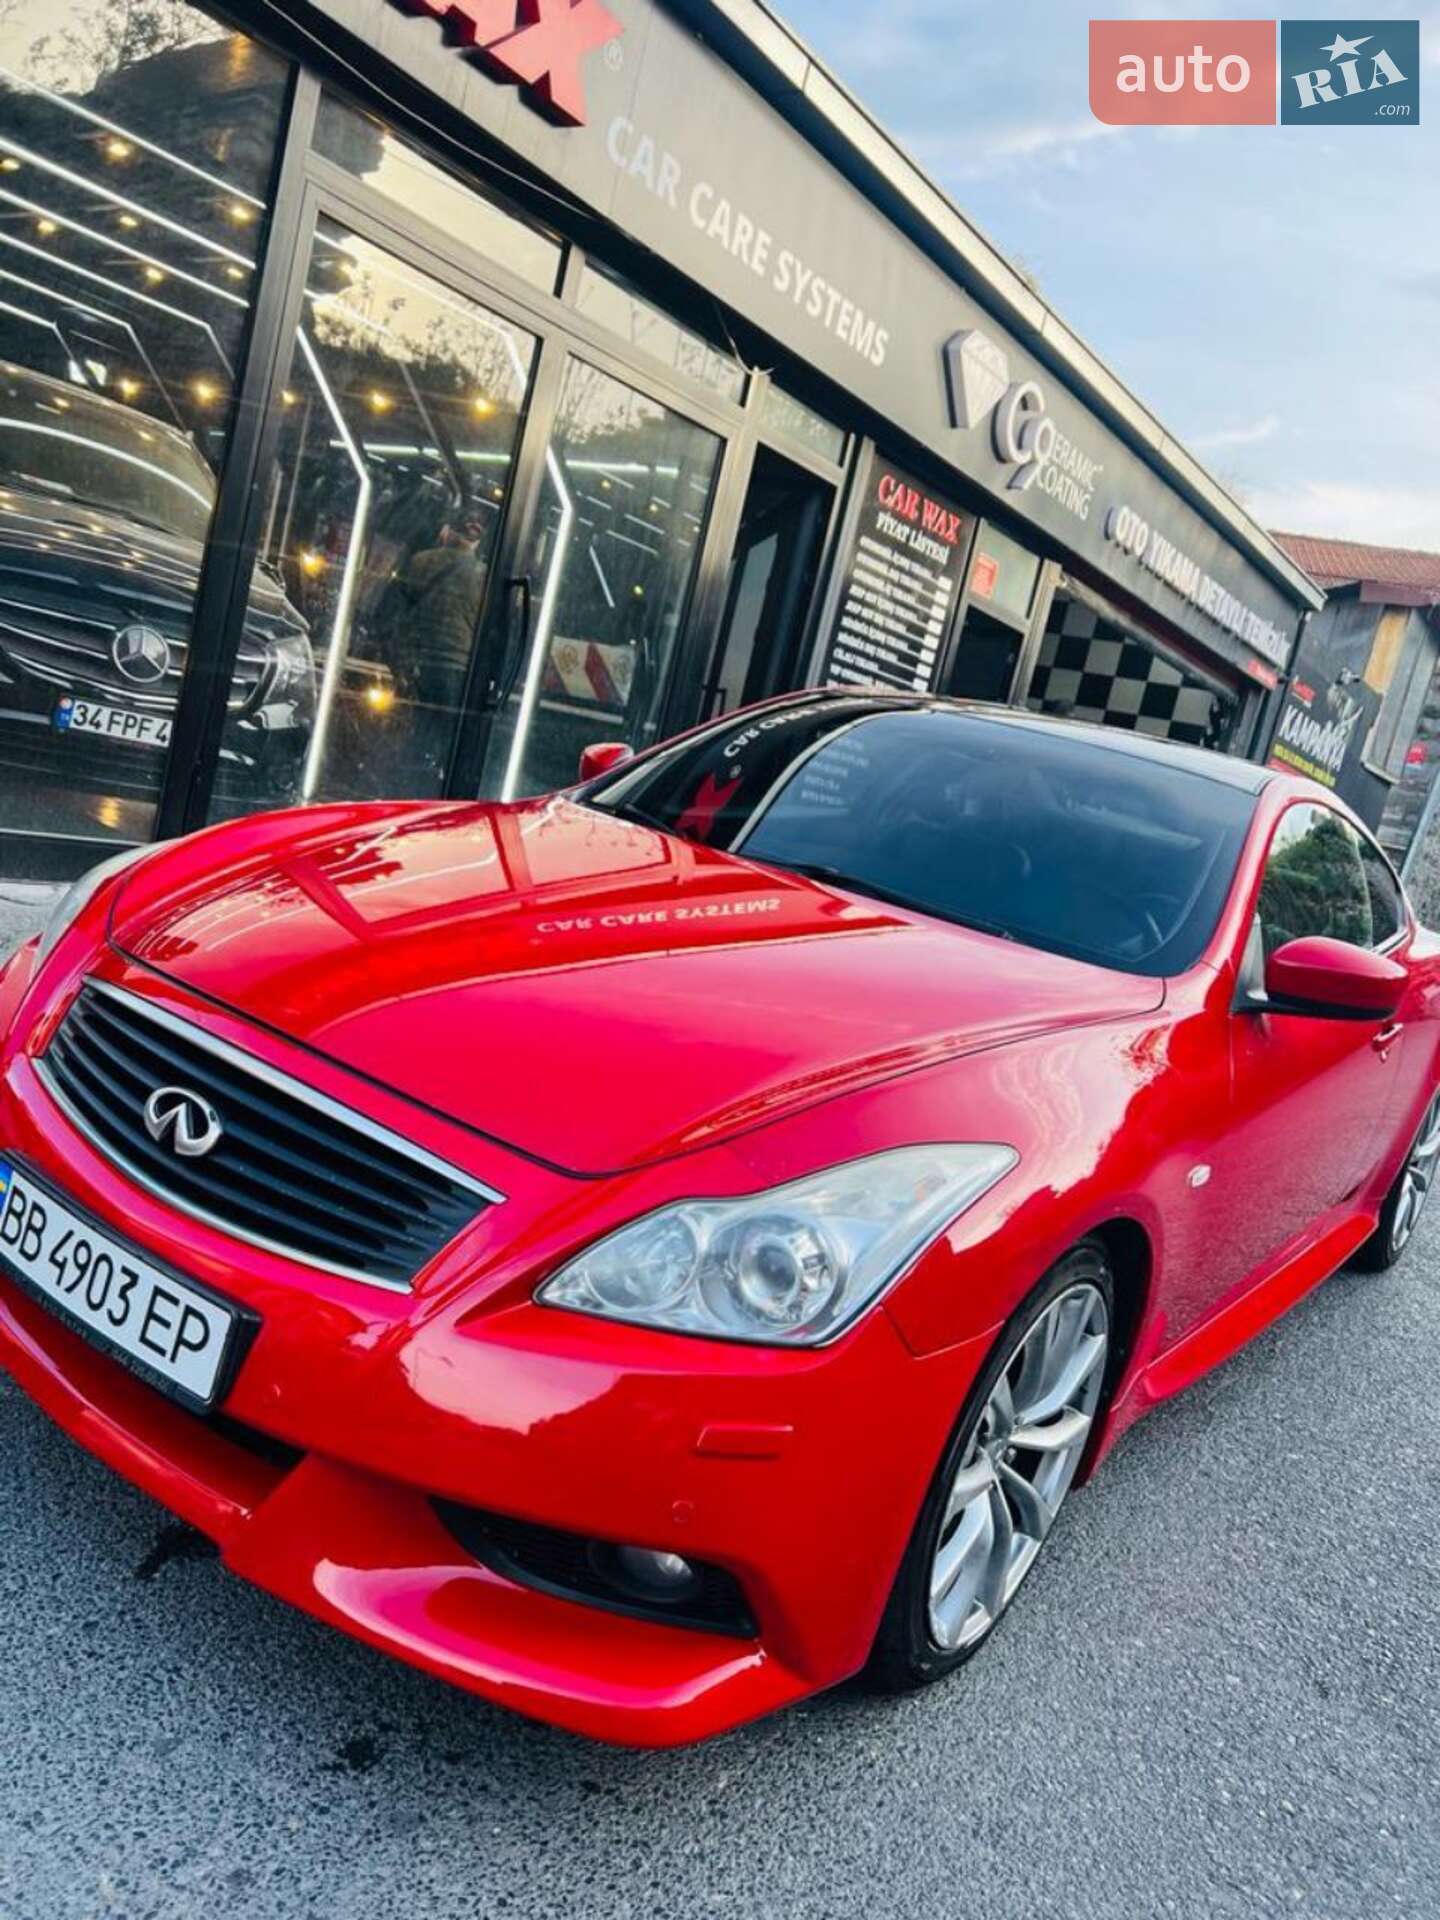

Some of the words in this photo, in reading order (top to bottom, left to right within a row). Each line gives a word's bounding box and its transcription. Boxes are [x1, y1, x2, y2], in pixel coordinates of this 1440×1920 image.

[607, 116, 681, 210] CAR
[689, 181, 773, 277] CARE
[773, 250, 889, 367] SYSTEMS
[878, 474, 920, 521] CAR
[921, 498, 961, 545] WAX
[1035, 460, 1092, 520] COATING
[876, 511, 910, 543] FİYAT
[1115, 505, 1150, 558] OTO
[1149, 529, 1201, 602] YIKAMA
[72, 703, 103, 731] 34
[106, 710, 154, 739] FPF
[155, 722, 171, 744] 4
[0, 1185, 48, 1263] BB
[48, 1229, 140, 1327] 4903
[139, 1284, 211, 1364] EP
